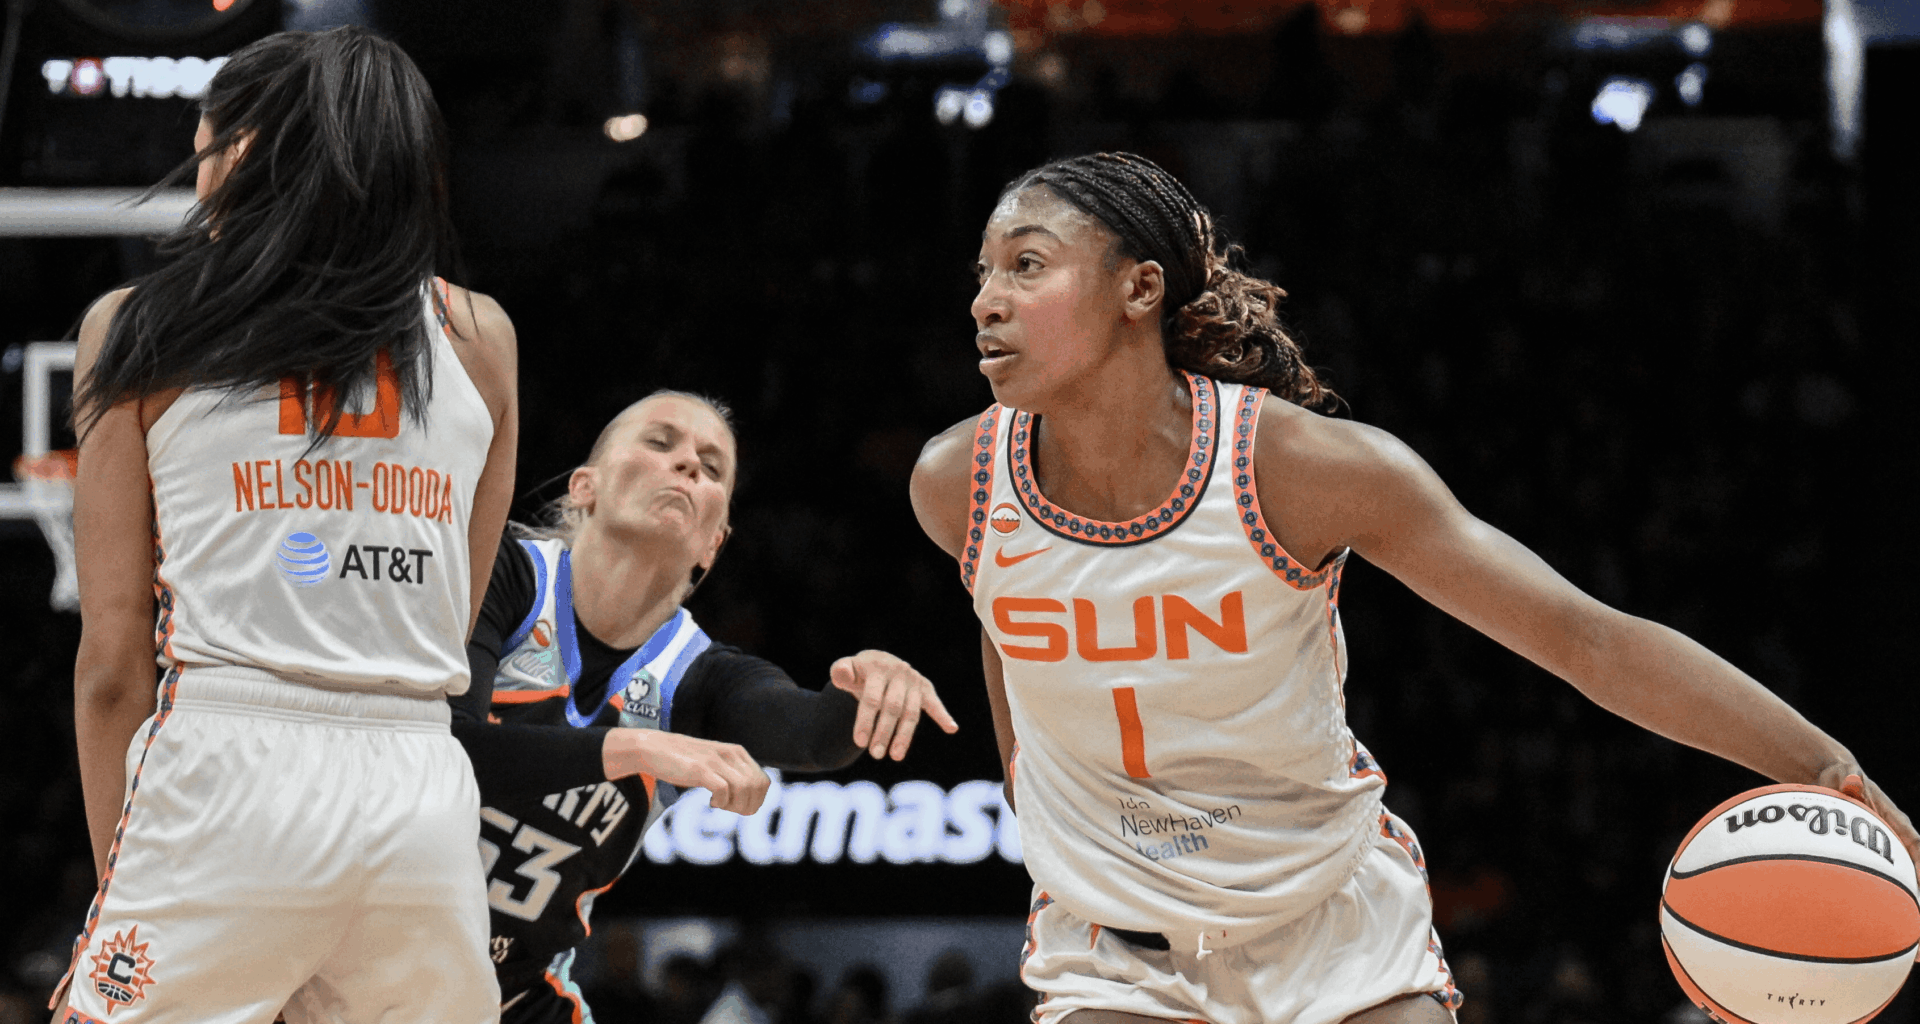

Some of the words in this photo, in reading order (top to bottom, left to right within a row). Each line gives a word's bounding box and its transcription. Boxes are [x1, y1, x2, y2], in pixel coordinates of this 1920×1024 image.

[232, 459, 453, 525] NELSON-ODODA
[339, 544, 433, 585] AT&T
[991, 591, 1248, 662] SUN
[624, 701, 658, 718] CLAYS
[1112, 687, 1152, 779] 1
[1724, 803, 1895, 866] Wilson
